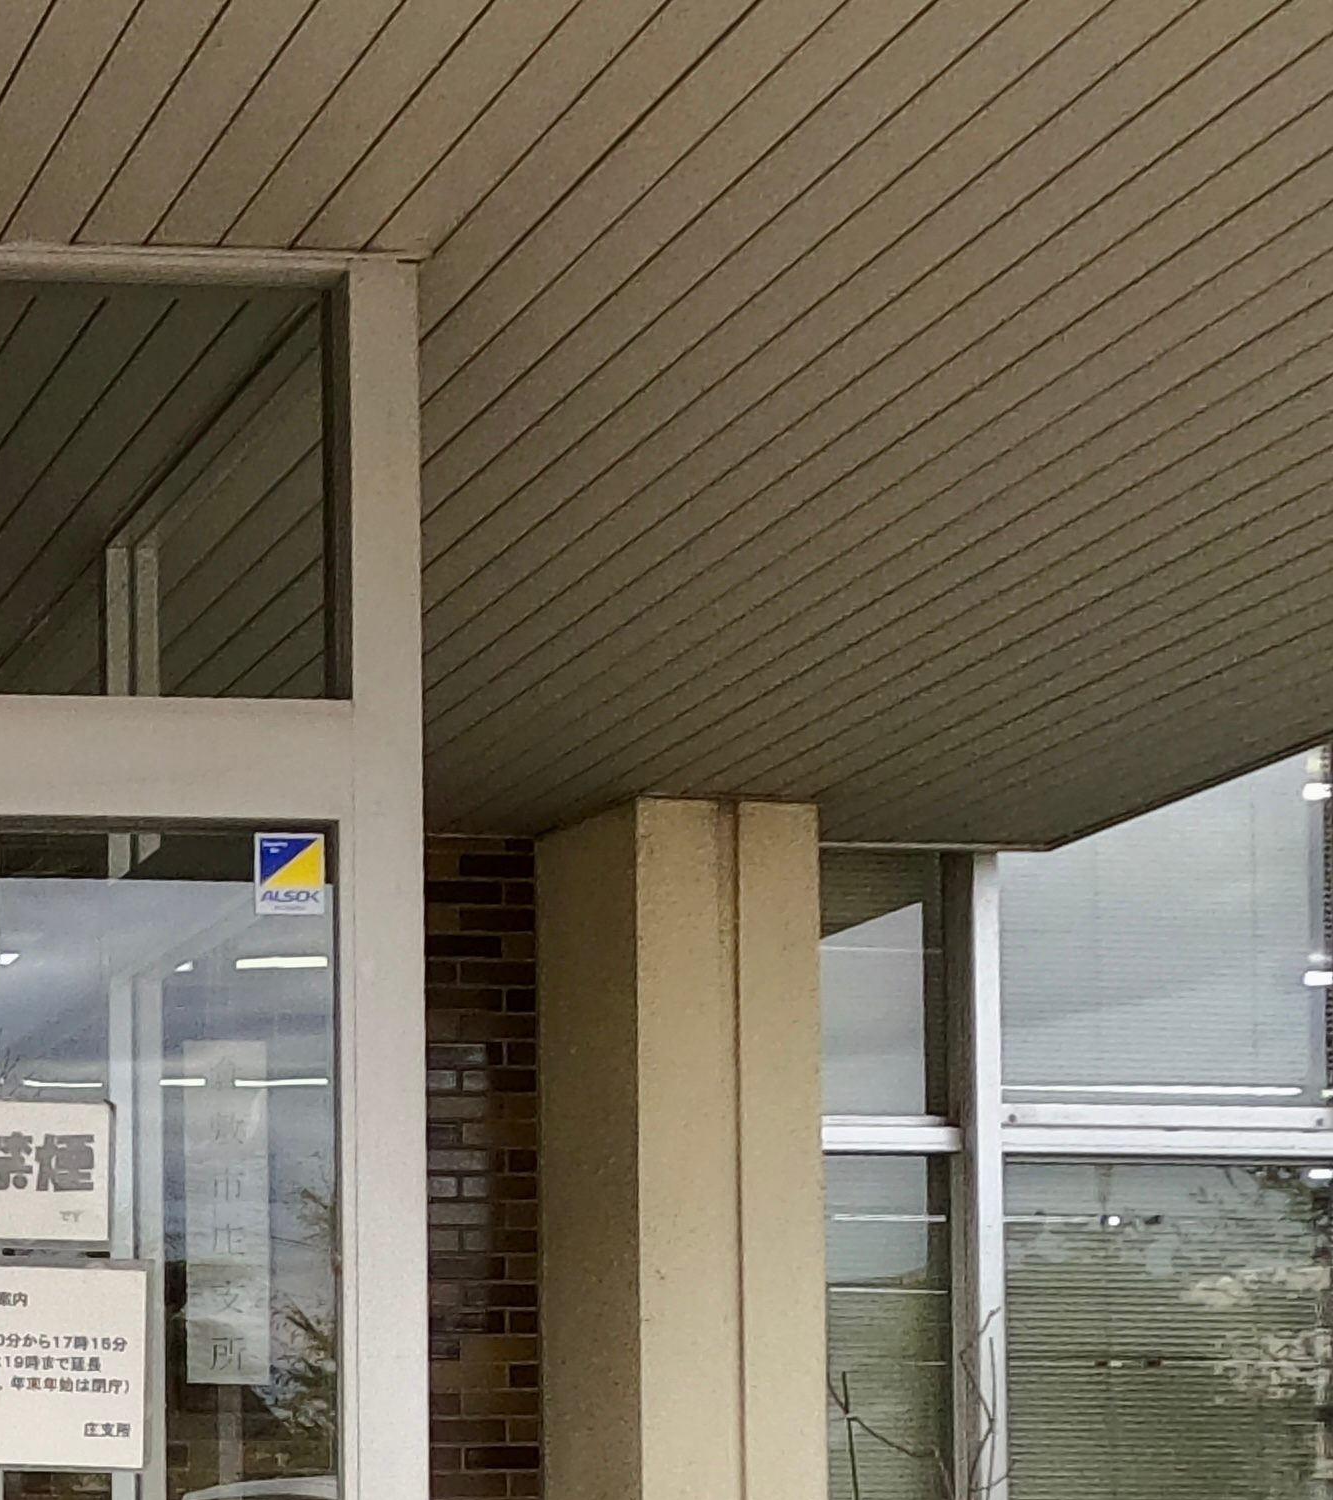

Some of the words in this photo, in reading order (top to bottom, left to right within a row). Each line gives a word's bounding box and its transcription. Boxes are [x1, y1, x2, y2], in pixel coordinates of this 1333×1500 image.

[260, 889, 320, 903] ALSOK
[59, 1209, 85, 1223] です
[83, 1422, 131, 1438] 庄支所
